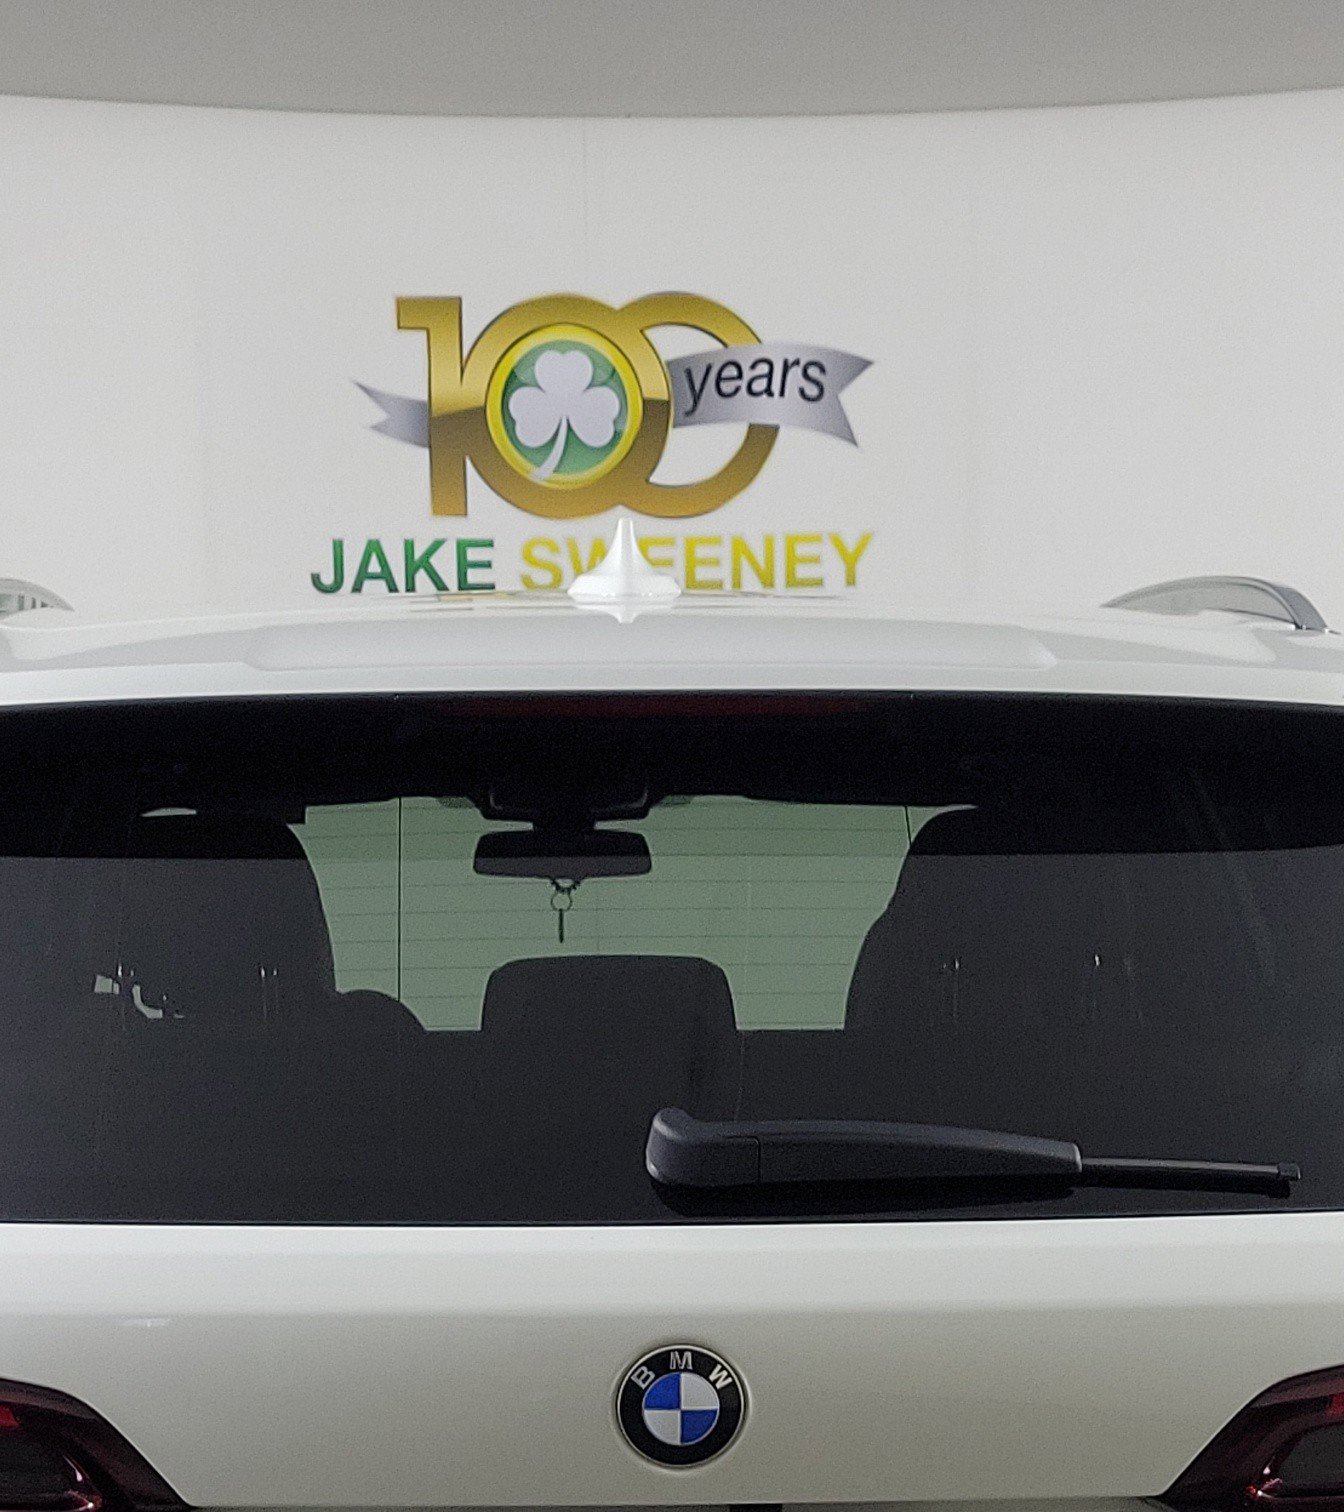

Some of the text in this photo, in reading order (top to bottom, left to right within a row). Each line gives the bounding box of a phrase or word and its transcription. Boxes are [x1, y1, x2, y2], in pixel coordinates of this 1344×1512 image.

[395, 290, 778, 520] 100
[683, 356, 827, 417] years
[311, 538, 494, 594] JAKE
[630, 1350, 733, 1391] BMW
